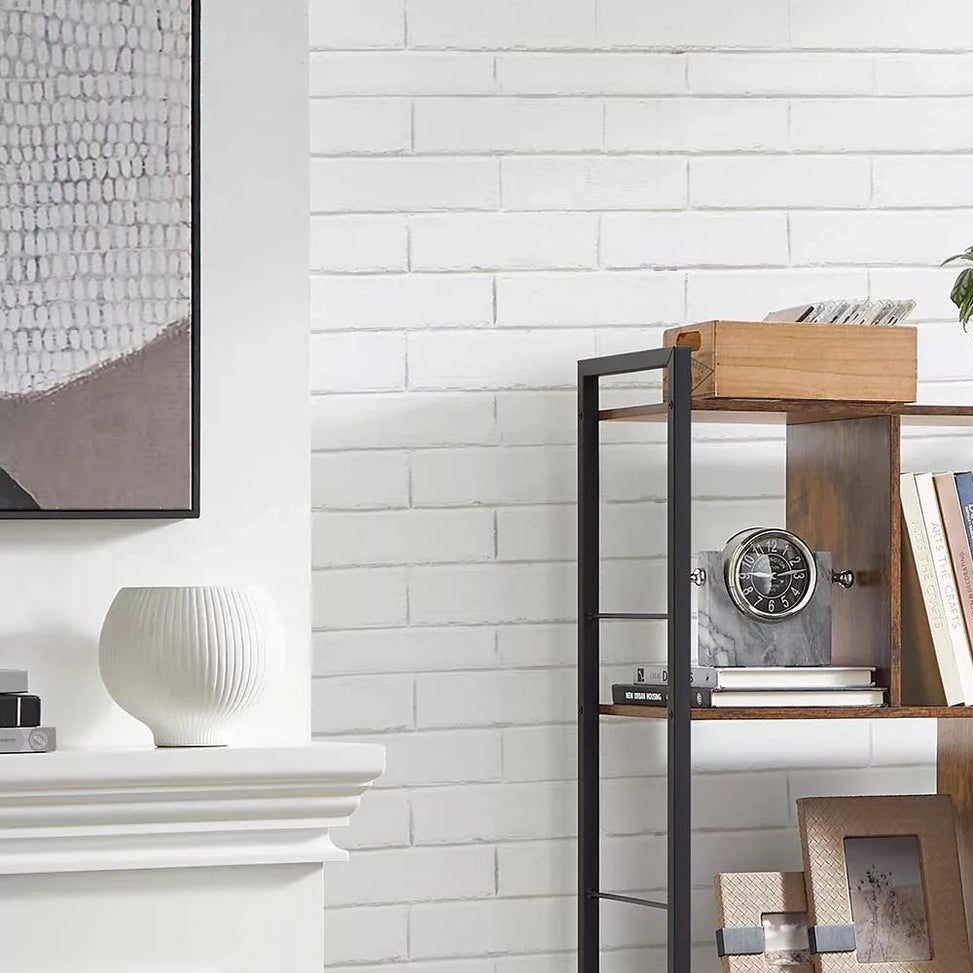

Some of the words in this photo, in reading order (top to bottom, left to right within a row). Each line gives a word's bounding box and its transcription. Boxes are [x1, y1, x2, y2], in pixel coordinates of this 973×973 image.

[753, 543, 765, 556] 11
[767, 540, 777, 552] 12
[784, 545, 790, 555] 1
[742, 556, 755, 568] 10
[790, 556, 800, 566] 2
[930, 521, 944, 551] ARTS
[937, 556, 950, 579] THE
[944, 584, 961, 629] CRAFTS
[742, 587, 753, 595] 8
[791, 587, 800, 596] 4
[753, 596, 763, 607] 7
[768, 600, 775, 612] 6
[781, 596, 790, 608] 5
